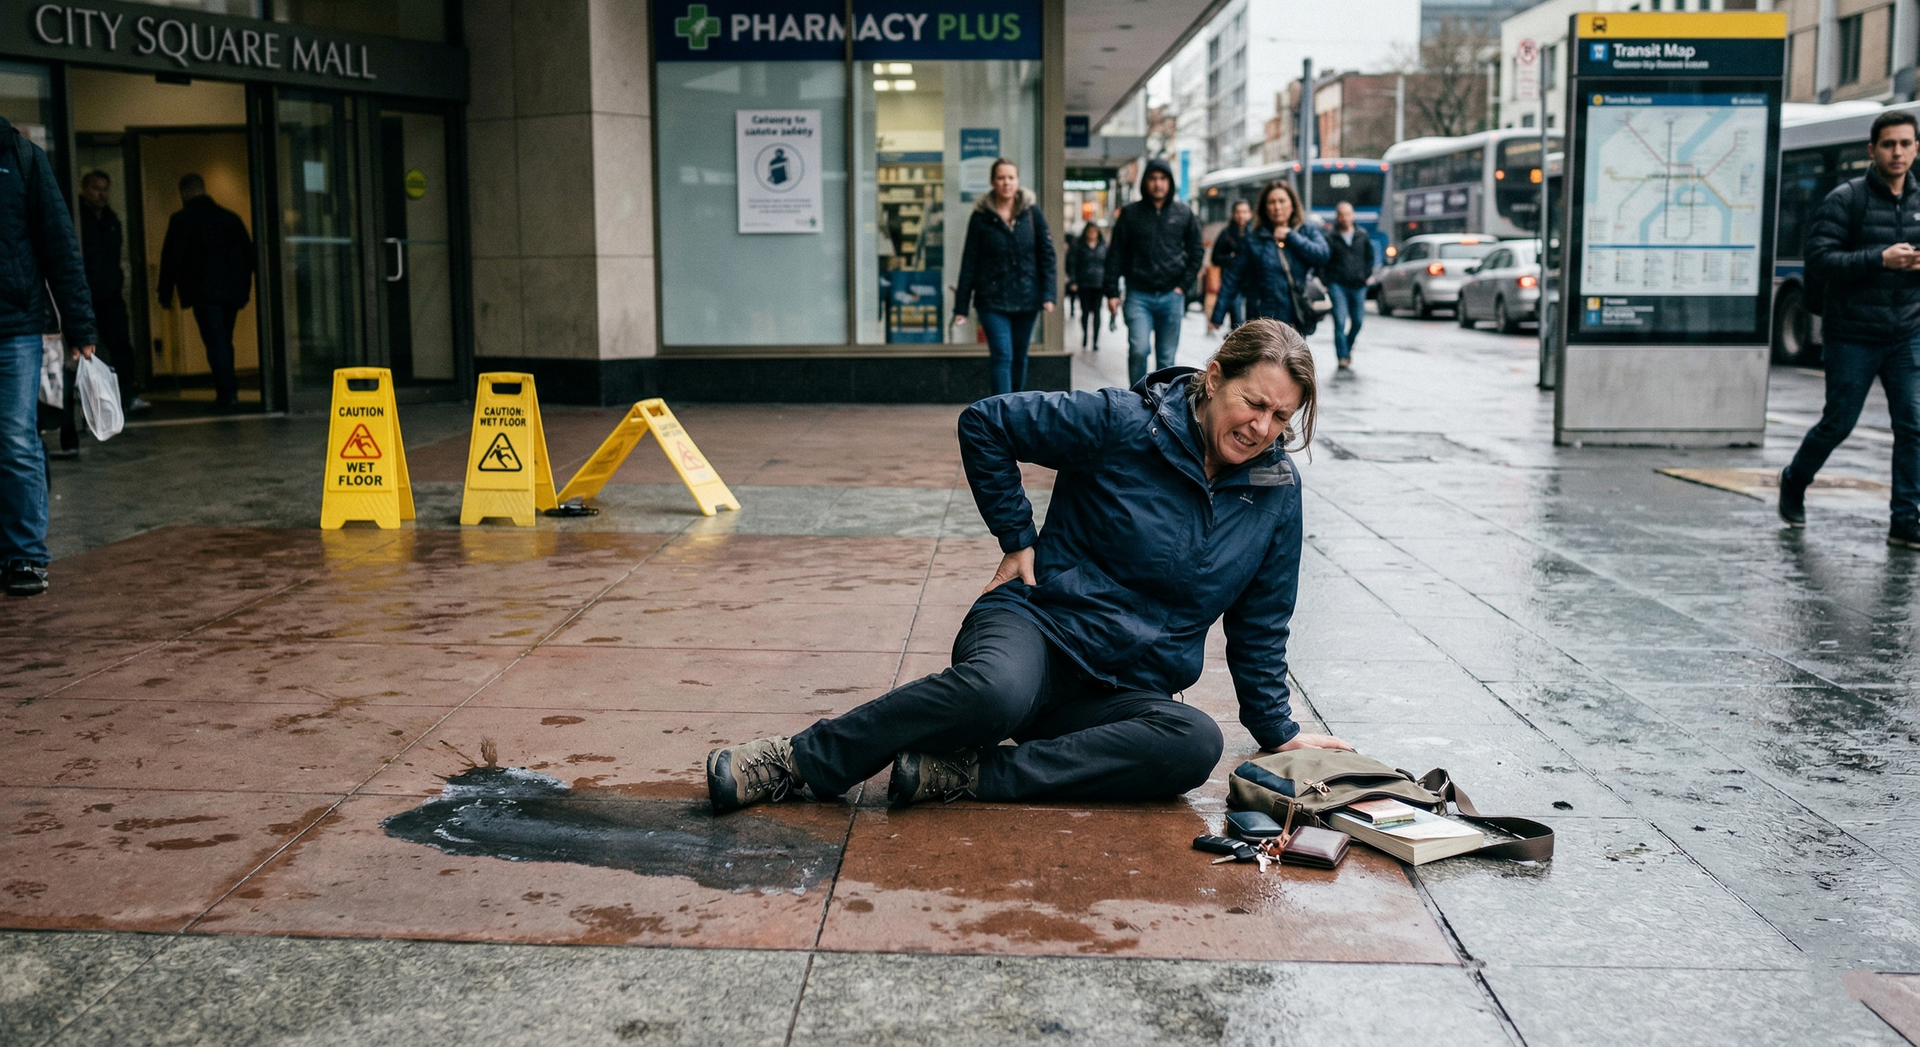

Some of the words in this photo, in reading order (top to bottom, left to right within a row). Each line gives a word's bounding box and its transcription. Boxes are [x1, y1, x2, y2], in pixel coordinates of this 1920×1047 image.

[731, 13, 928, 41] PHARMACY
[938, 13, 1021, 41] PLUS
[35, 4, 123, 51] CITY
[136, 15, 282, 68] SQUARE
[291, 36, 376, 79] MALL
[1613, 43, 1661, 58] Transit
[1663, 43, 1696, 61] Map
[339, 407, 384, 417] CAUTION
[484, 407, 524, 416] CAUTION:
[480, 418, 498, 426] WET
[499, 418, 526, 427] FLOOR
[346, 462, 375, 473] WET
[338, 475, 383, 486] FLOOR
